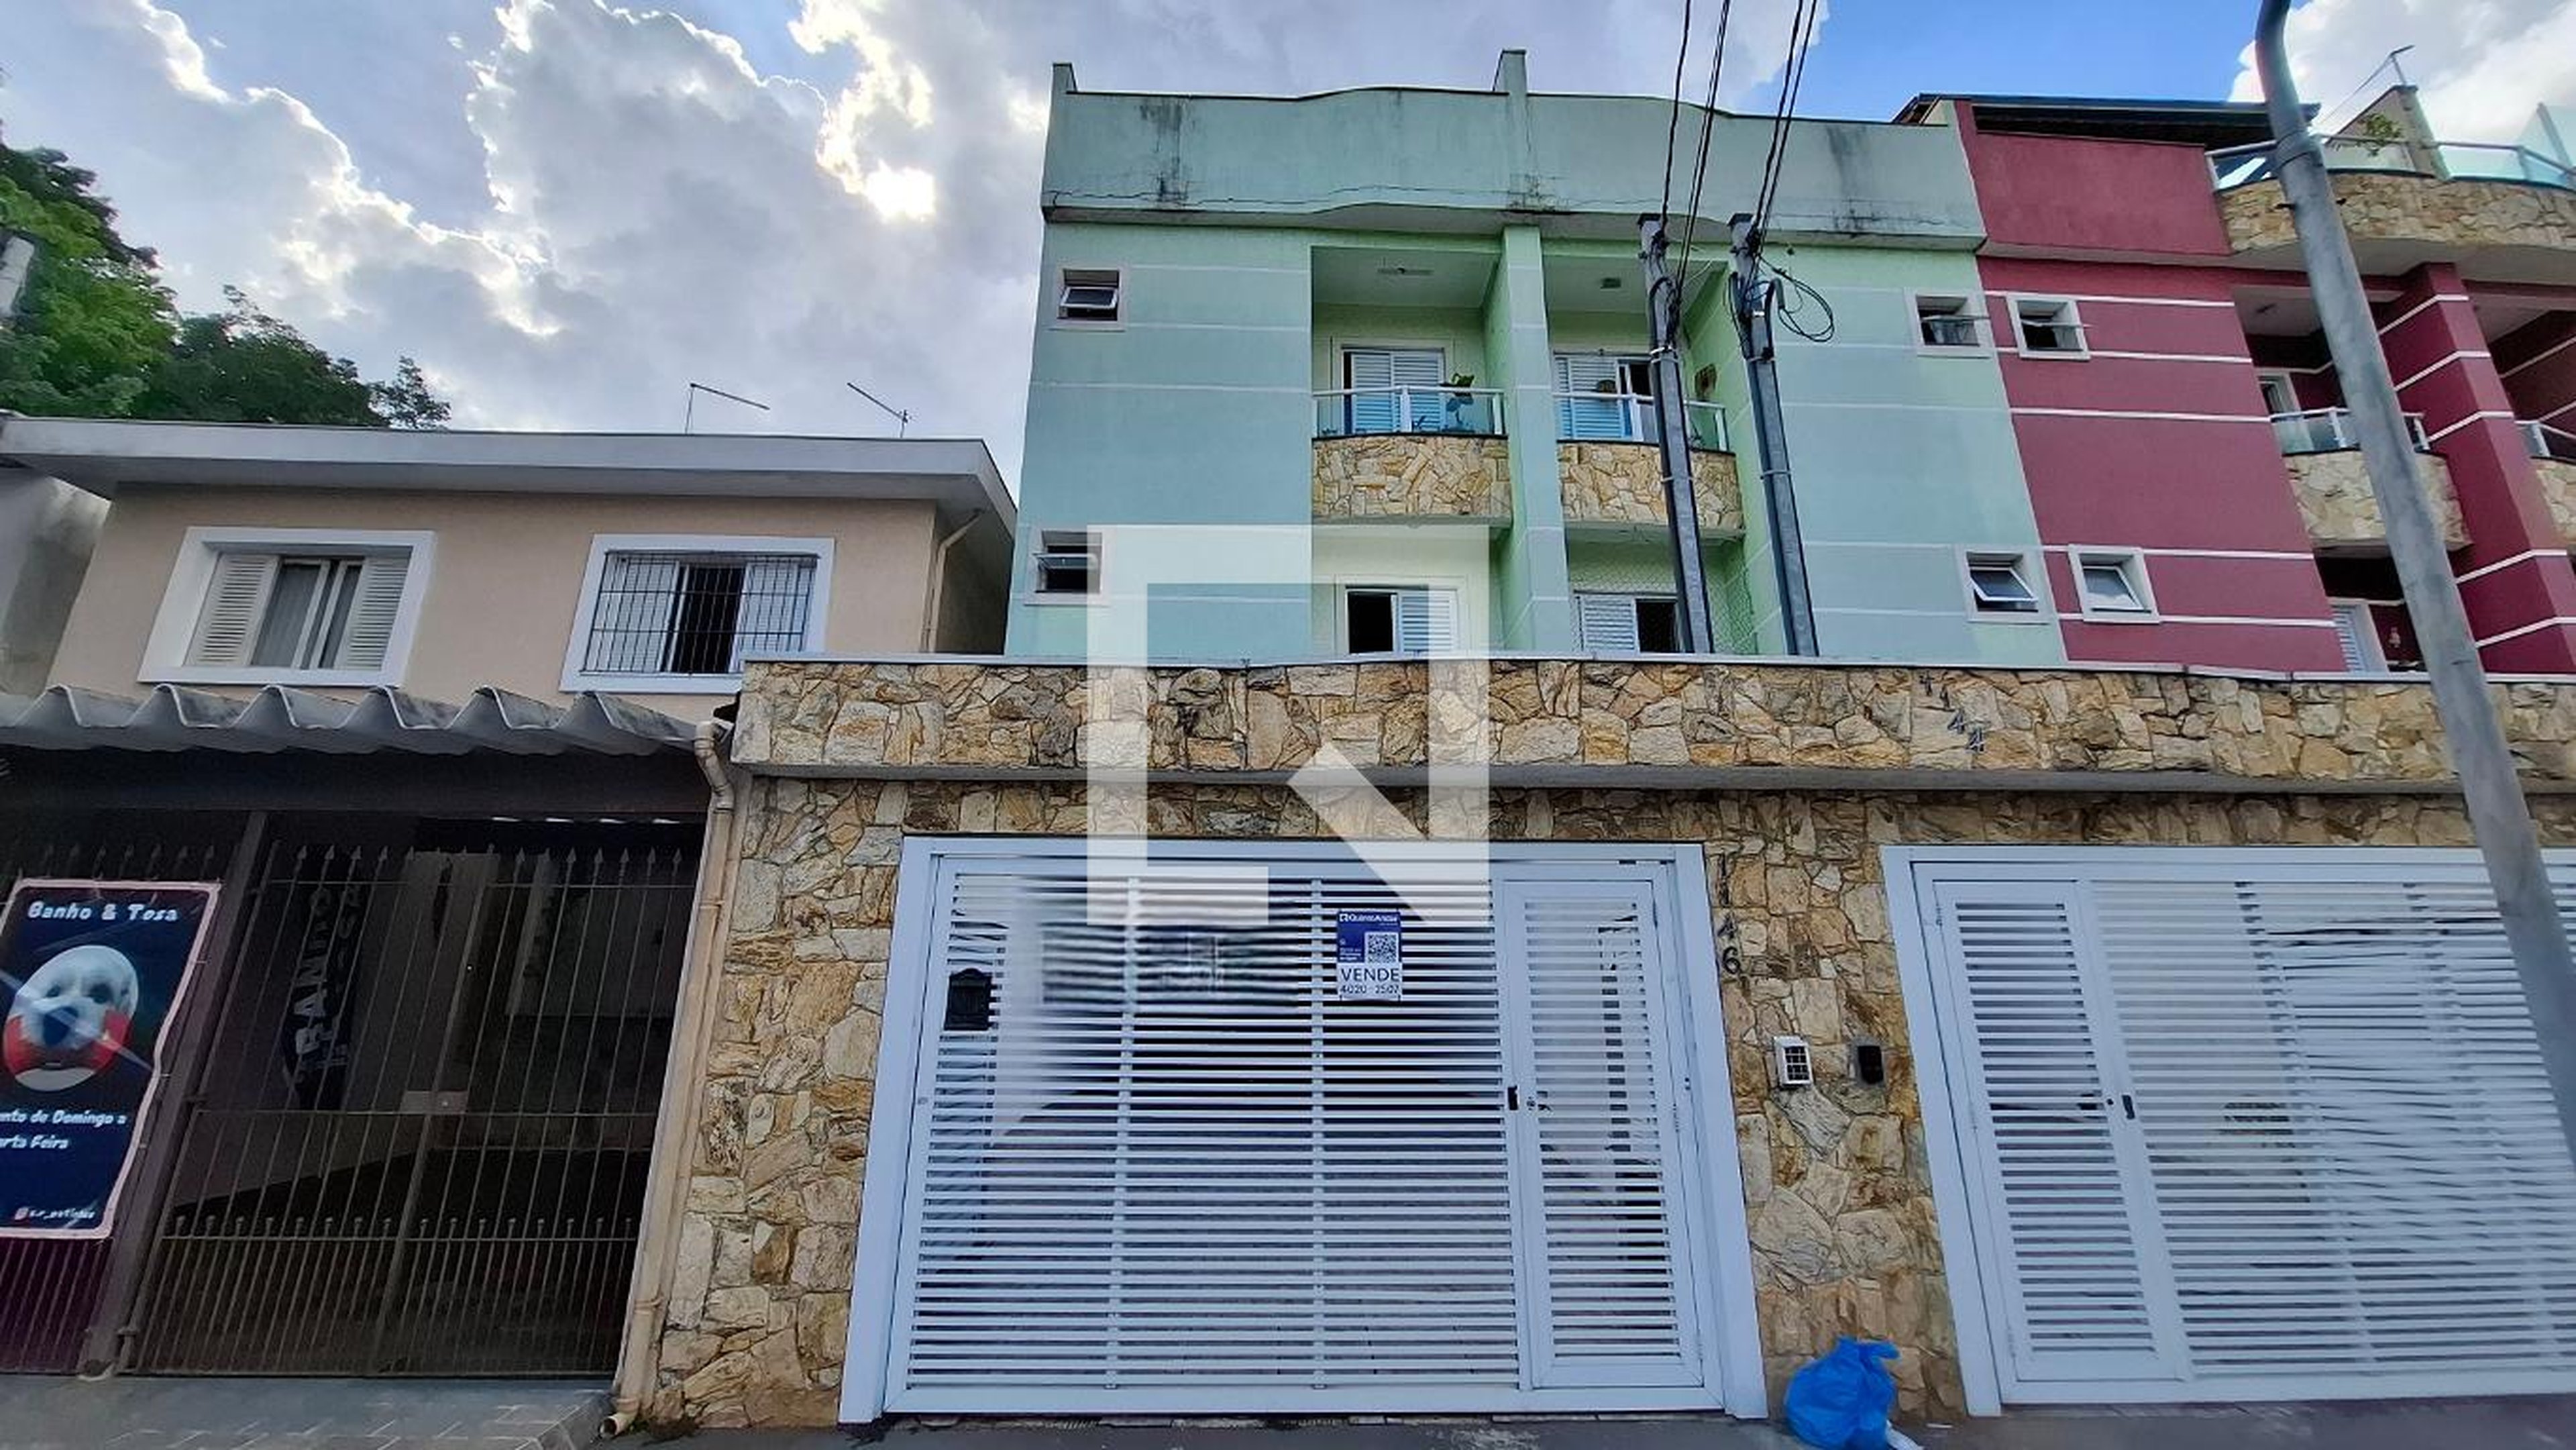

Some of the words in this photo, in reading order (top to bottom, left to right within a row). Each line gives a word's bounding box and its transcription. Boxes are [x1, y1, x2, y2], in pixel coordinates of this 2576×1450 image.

[28, 900, 92, 920] Banho
[102, 904, 117, 921] &
[128, 904, 178, 921] Tosa
[1341, 968, 1399, 982] VENDE
[30, 1110, 49, 1123] de
[52, 1110, 114, 1127] Domingo
[117, 1115, 127, 1124] a
[30, 1135, 68, 1149] Feira
